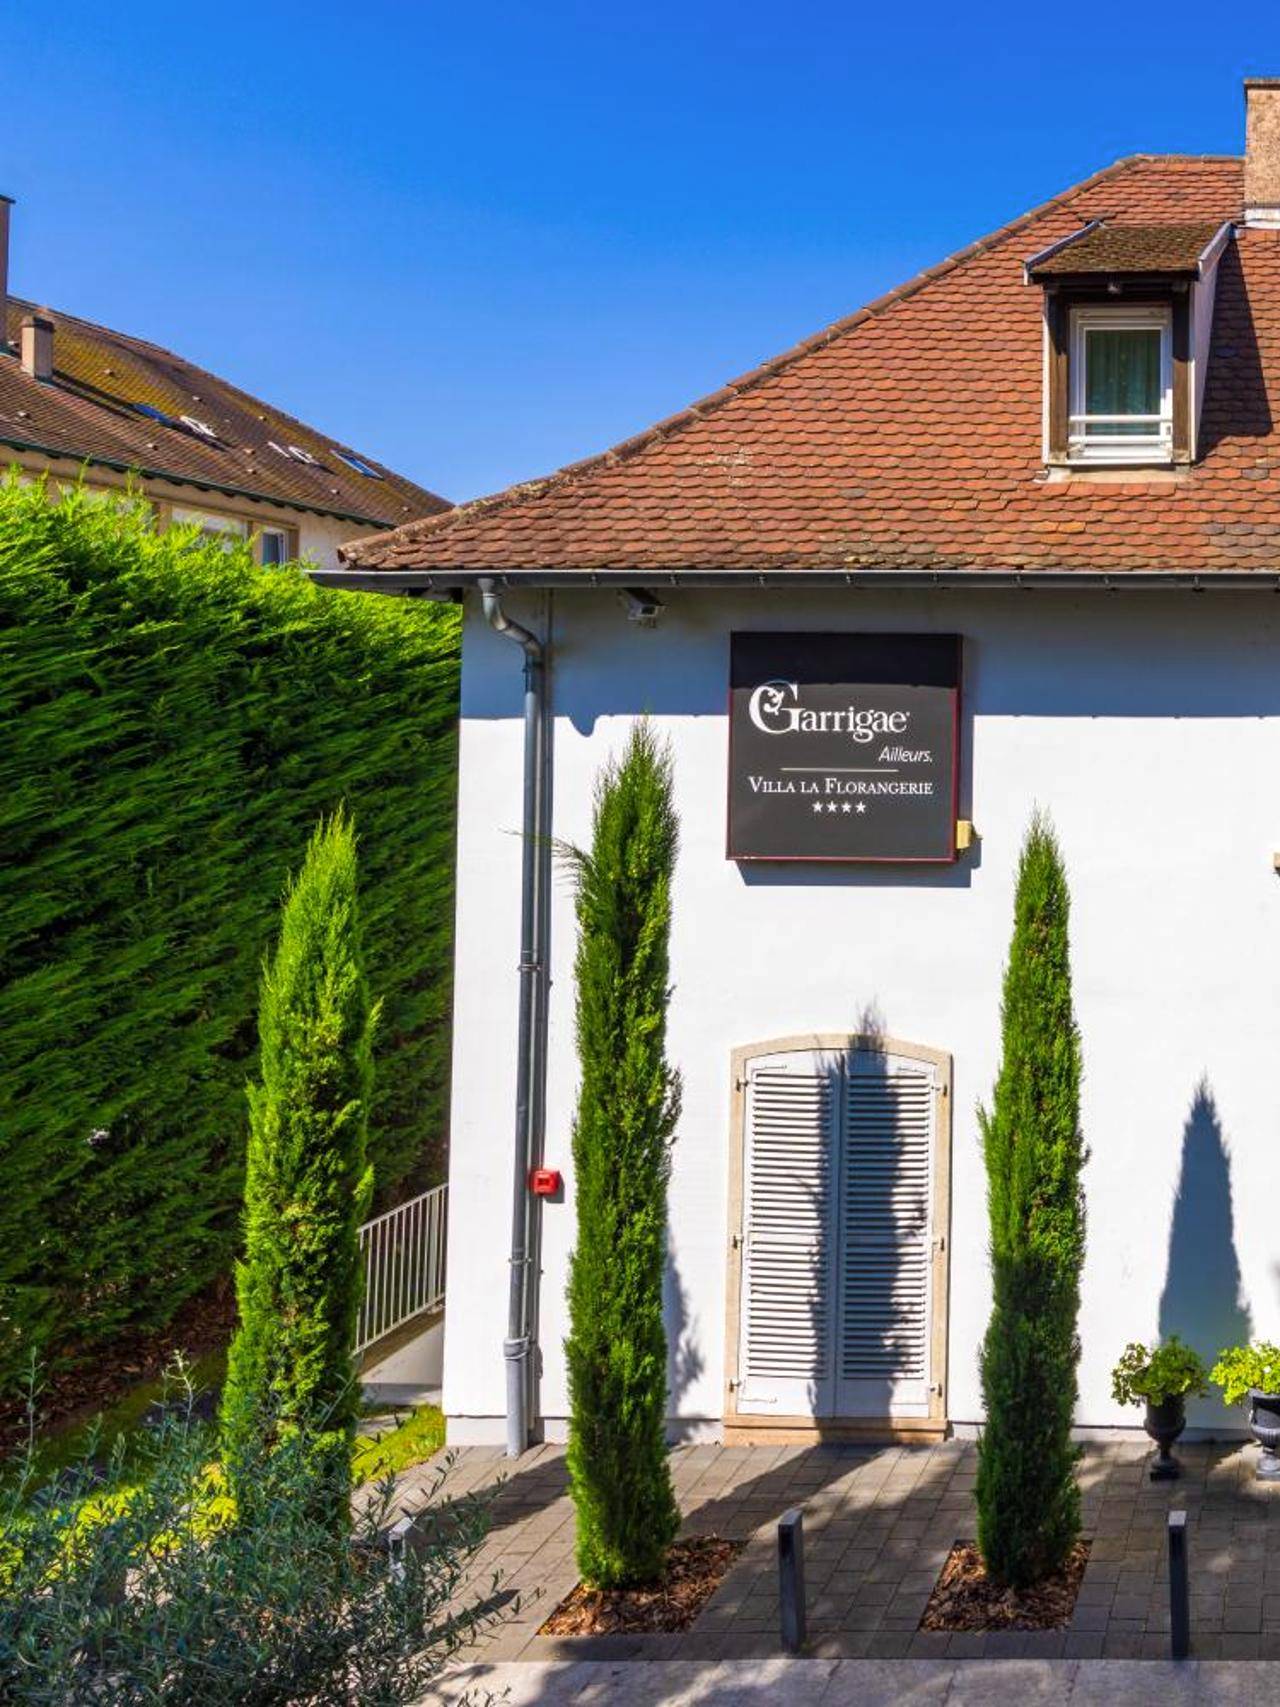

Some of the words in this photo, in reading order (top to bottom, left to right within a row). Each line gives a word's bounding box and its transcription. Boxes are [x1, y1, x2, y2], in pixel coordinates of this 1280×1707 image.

[749, 679, 909, 743] Garrigae
[748, 776, 796, 794] VILLA
[801, 781, 820, 794] LA
[825, 777, 933, 795] FLORANGERIE
